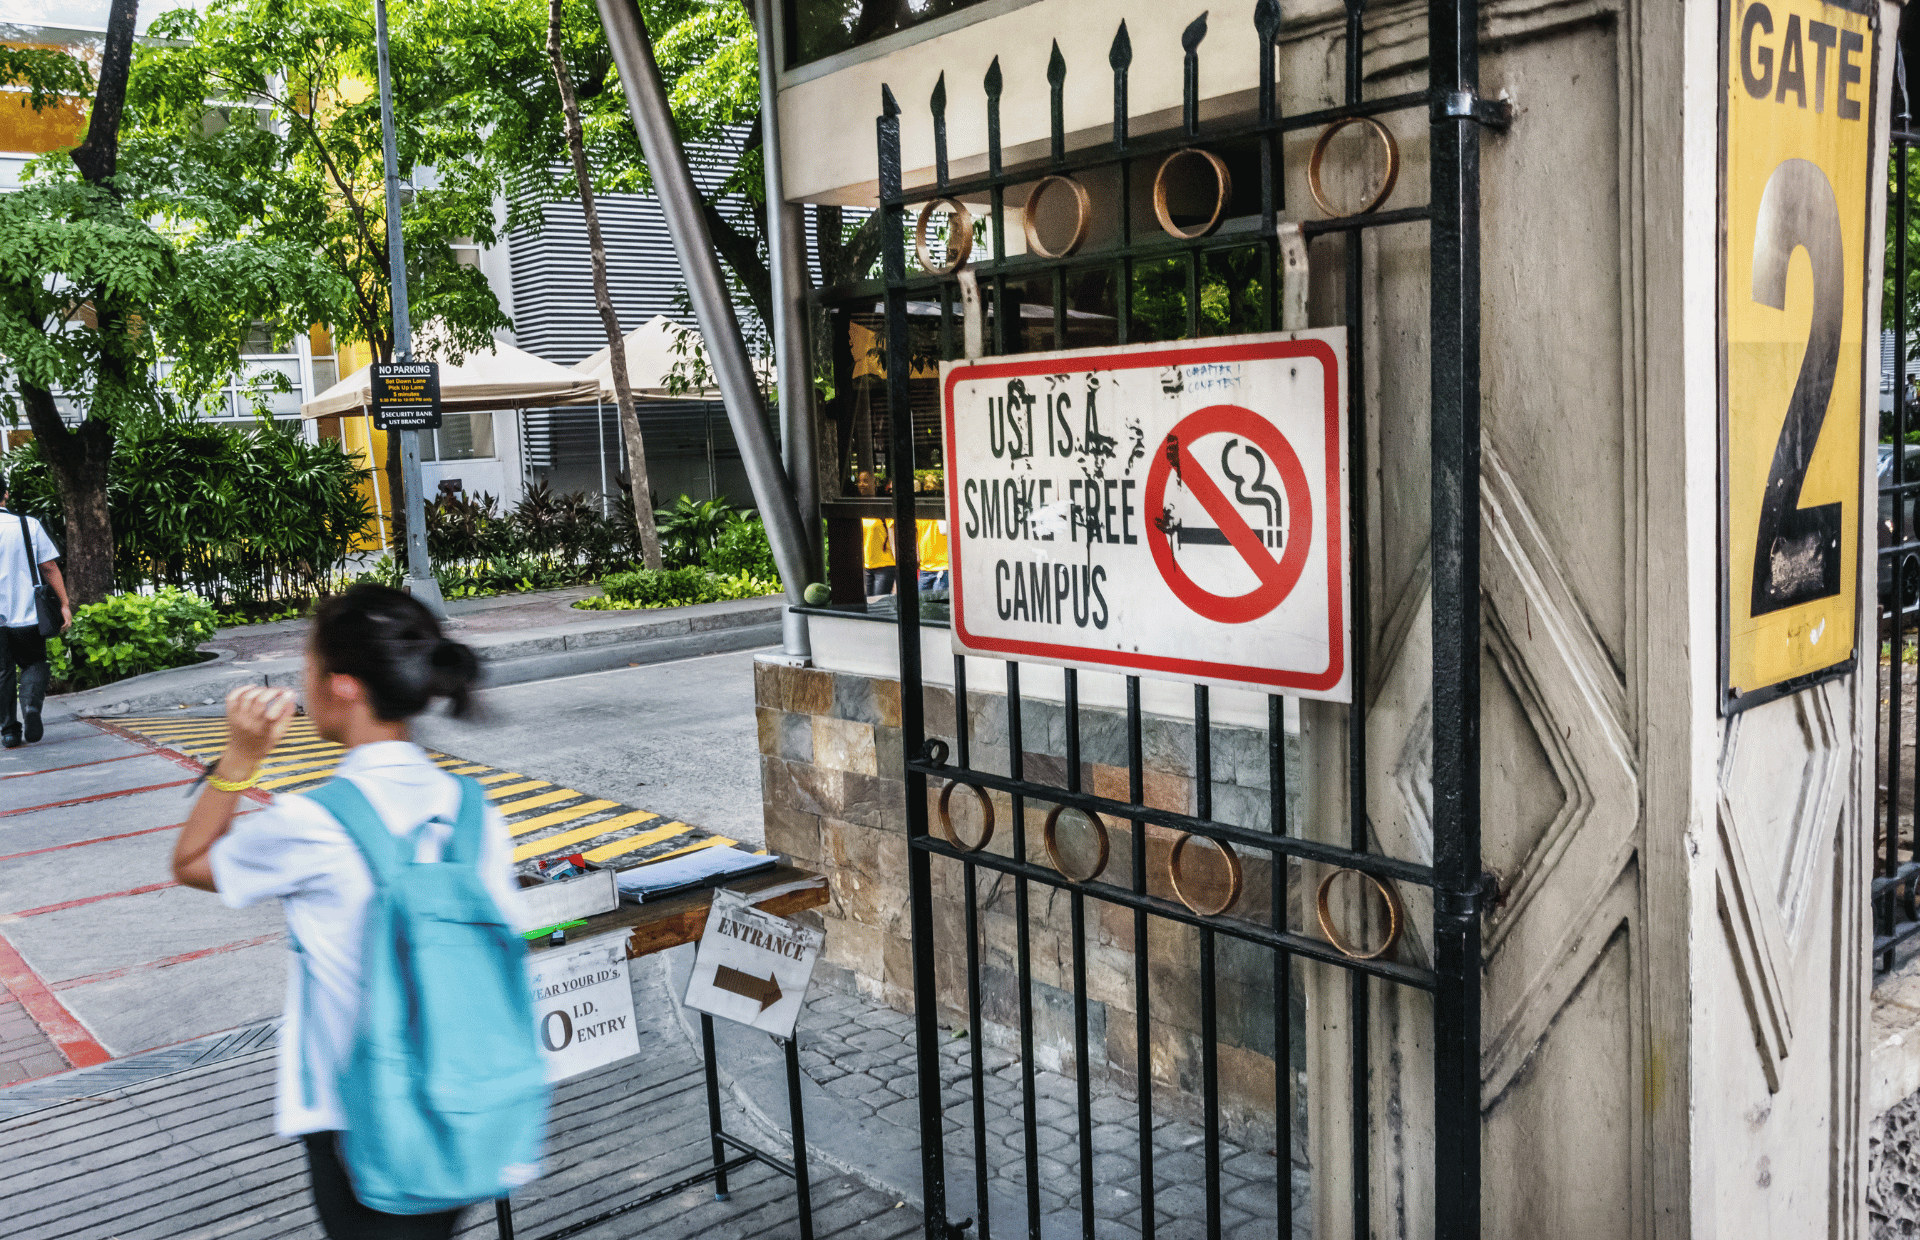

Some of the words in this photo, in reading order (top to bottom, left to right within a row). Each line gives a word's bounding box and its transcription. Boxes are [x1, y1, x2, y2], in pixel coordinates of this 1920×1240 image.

[1740, 2, 1863, 121] GATE
[379, 366, 391, 374] NO
[393, 365, 430, 374] PARKING
[1750, 158, 1844, 618] 2
[989, 394, 1036, 459] UST
[1047, 392, 1073, 457] IS
[1084, 392, 1102, 456] A
[964, 478, 1054, 541] SMOKE
[1069, 479, 1138, 545] FREE
[996, 559, 1108, 630] CAMPUS
[717, 917, 806, 961] ENTRANCE
[562, 974, 595, 992] YOUR
[573, 1001, 598, 1018] I.D.
[577, 1015, 627, 1043] ENTRY
